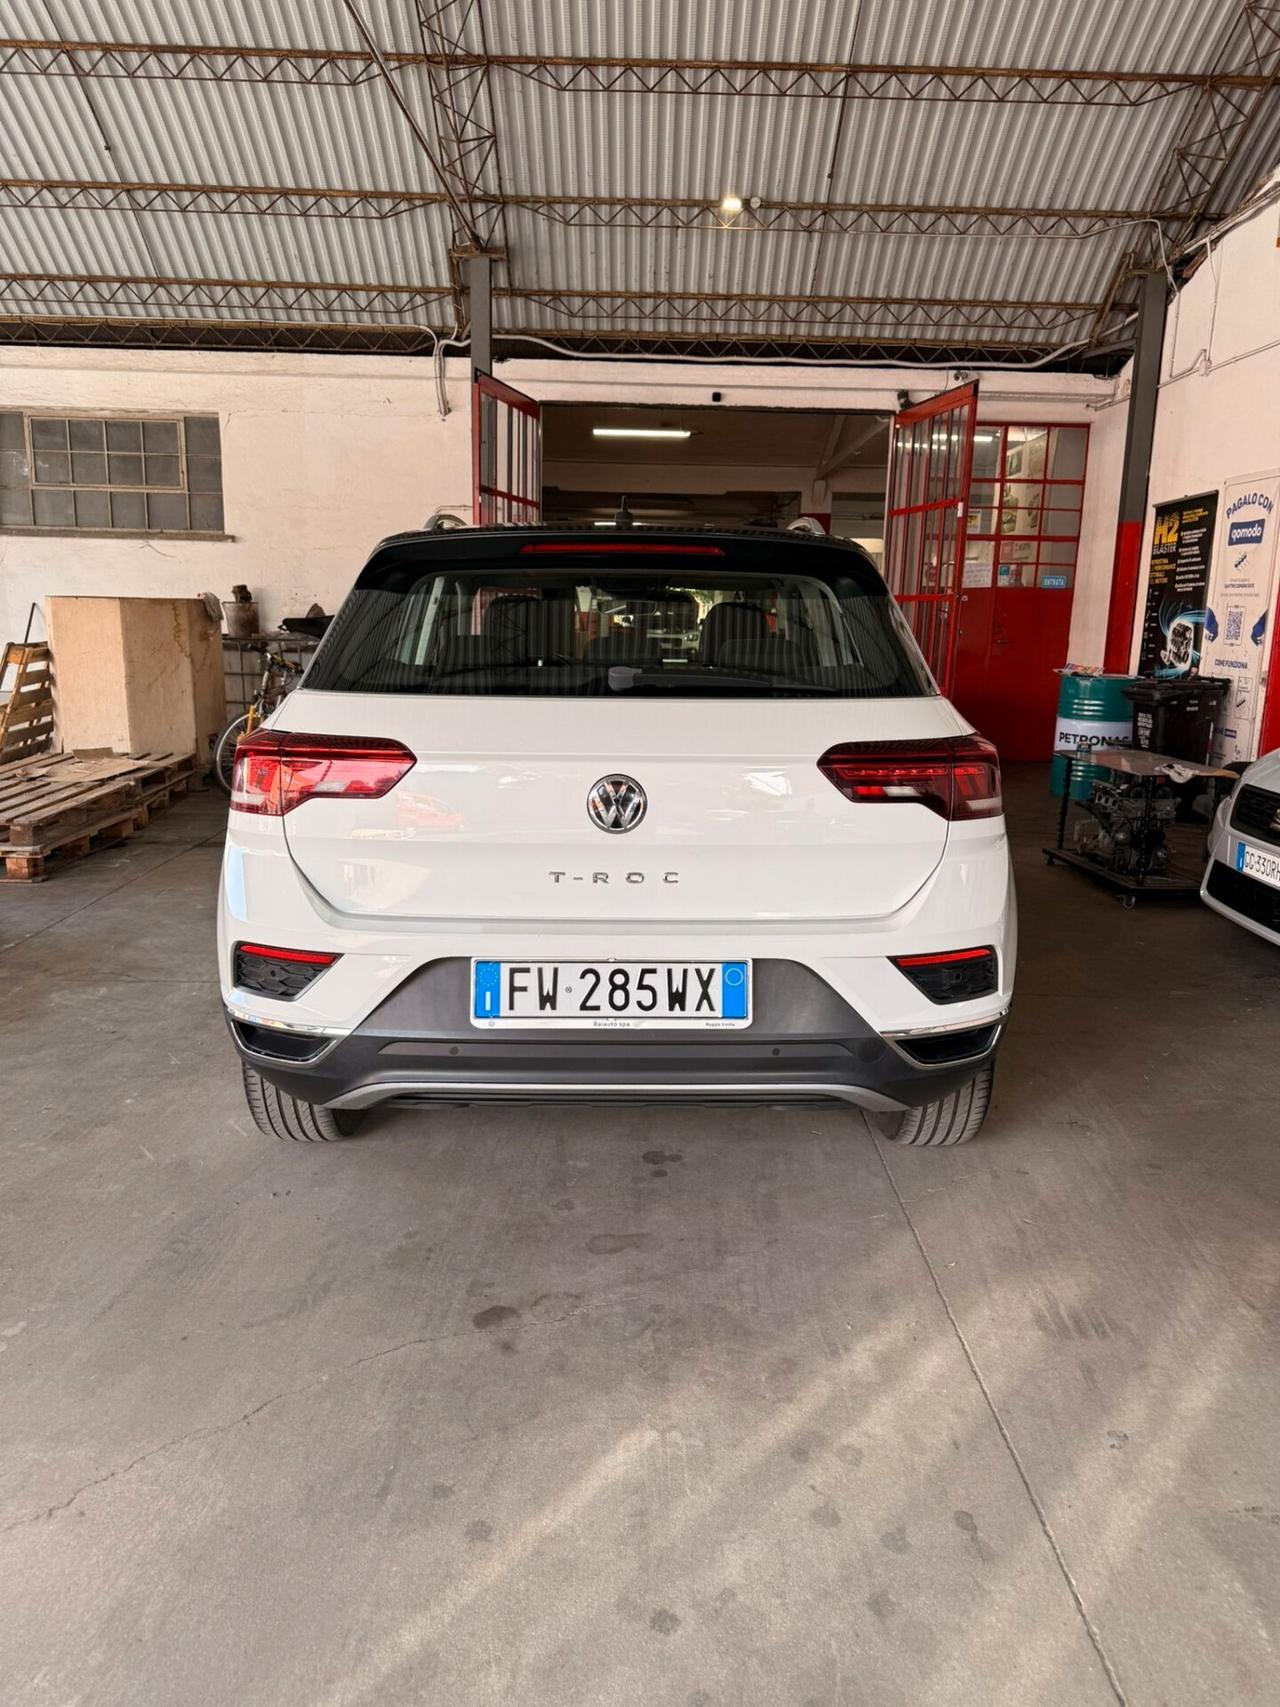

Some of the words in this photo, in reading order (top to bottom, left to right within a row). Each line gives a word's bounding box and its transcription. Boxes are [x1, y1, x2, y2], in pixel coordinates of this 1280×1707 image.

[1226, 492, 1258, 519] PAGALO
[1258, 493, 1274, 515] CON
[1154, 511, 1179, 545] H2
[548, 871, 679, 884] T-ROC
[508, 967, 559, 1011] FW
[578, 967, 716, 1012] 285WX
